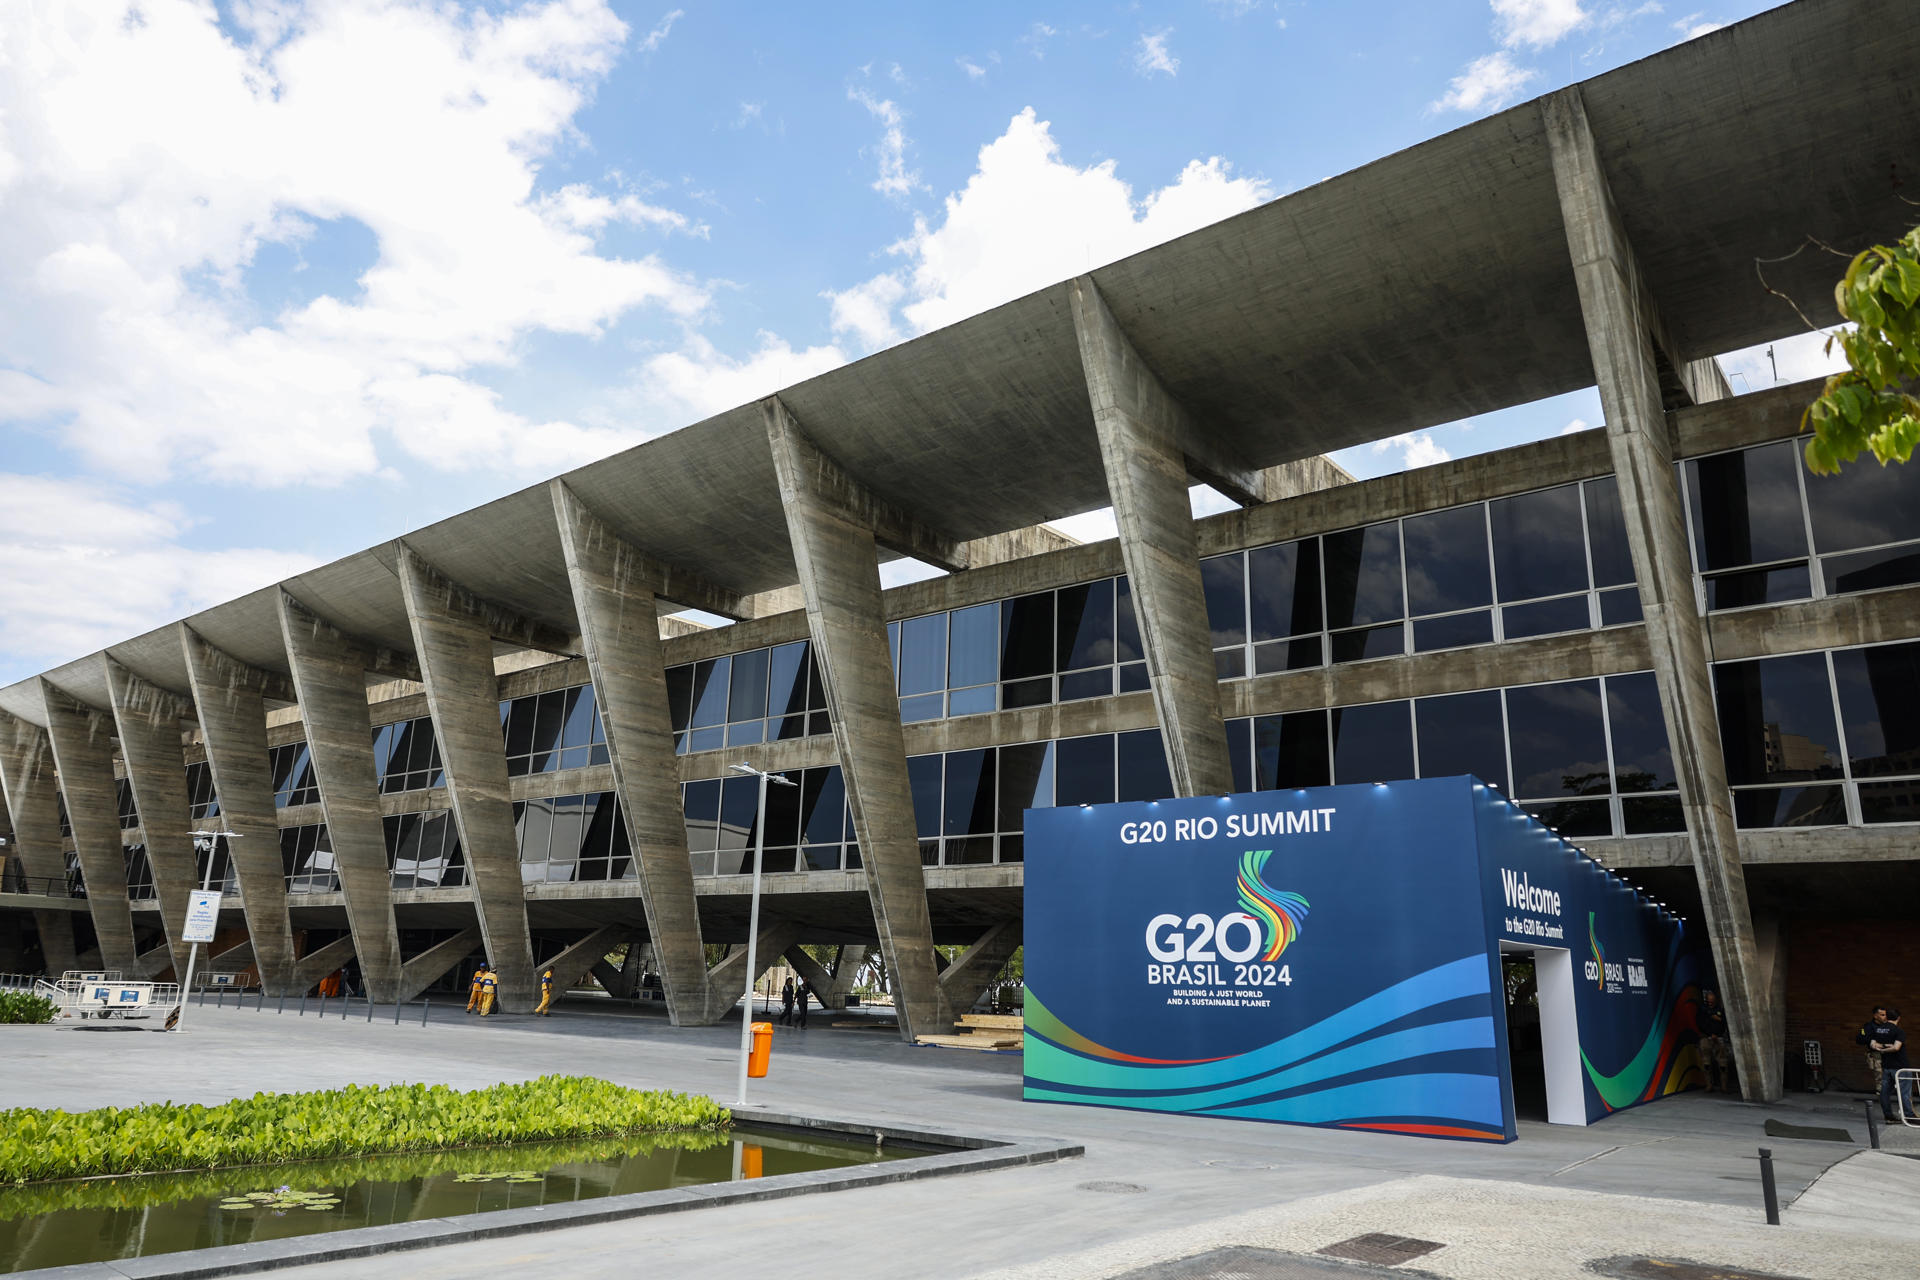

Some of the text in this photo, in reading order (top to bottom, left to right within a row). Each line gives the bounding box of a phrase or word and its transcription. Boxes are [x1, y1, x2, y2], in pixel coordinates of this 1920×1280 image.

[1120, 808, 1336, 844] G20 RIO SUMMIT
[1501, 868, 1561, 917] Welcome
[1145, 912, 1262, 963] G20
[1505, 916, 1564, 940] to the G20 Rio Summit
[1148, 964, 1293, 986] BRASIL 2024
[1585, 960, 1625, 982] G20 BRASIL
[1173, 989, 1263, 998] BUILDING A JUST WORLD
[1184, 998, 1190, 1006] A
[1191, 998, 1240, 1007] SUSTAINABLE
[1241, 999, 1271, 1007] PLANET
